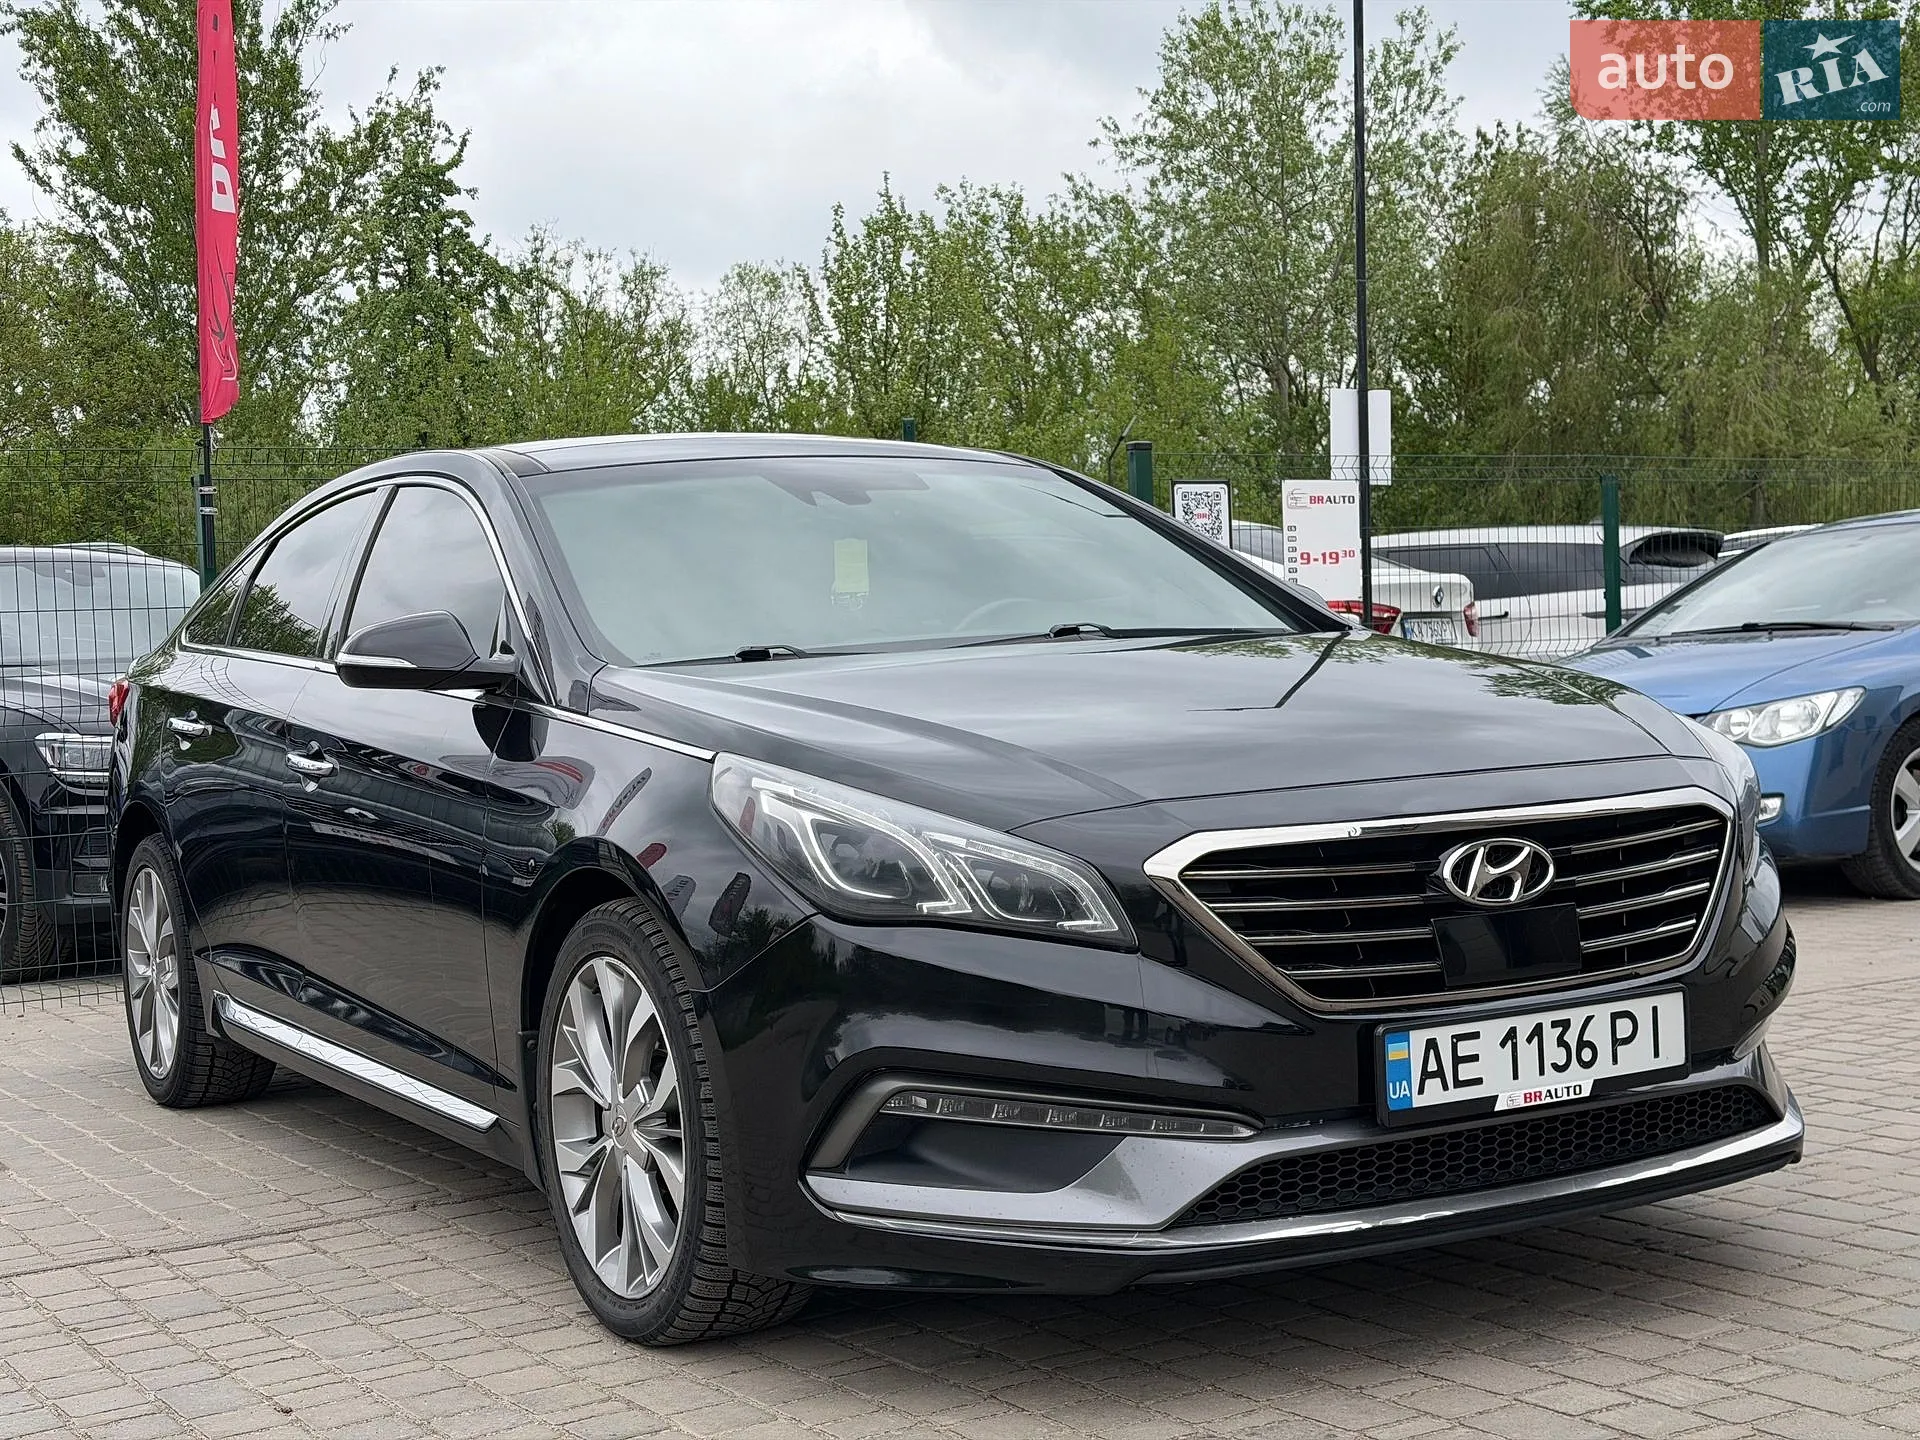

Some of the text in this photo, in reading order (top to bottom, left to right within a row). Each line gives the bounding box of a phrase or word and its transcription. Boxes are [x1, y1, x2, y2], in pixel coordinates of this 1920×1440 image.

[1309, 495, 1356, 504] BRAUTO
[1417, 1005, 1660, 1095] AE 1136 PI
[1389, 1080, 1410, 1099] UA
[1523, 1084, 1583, 1104] BRAUTO
